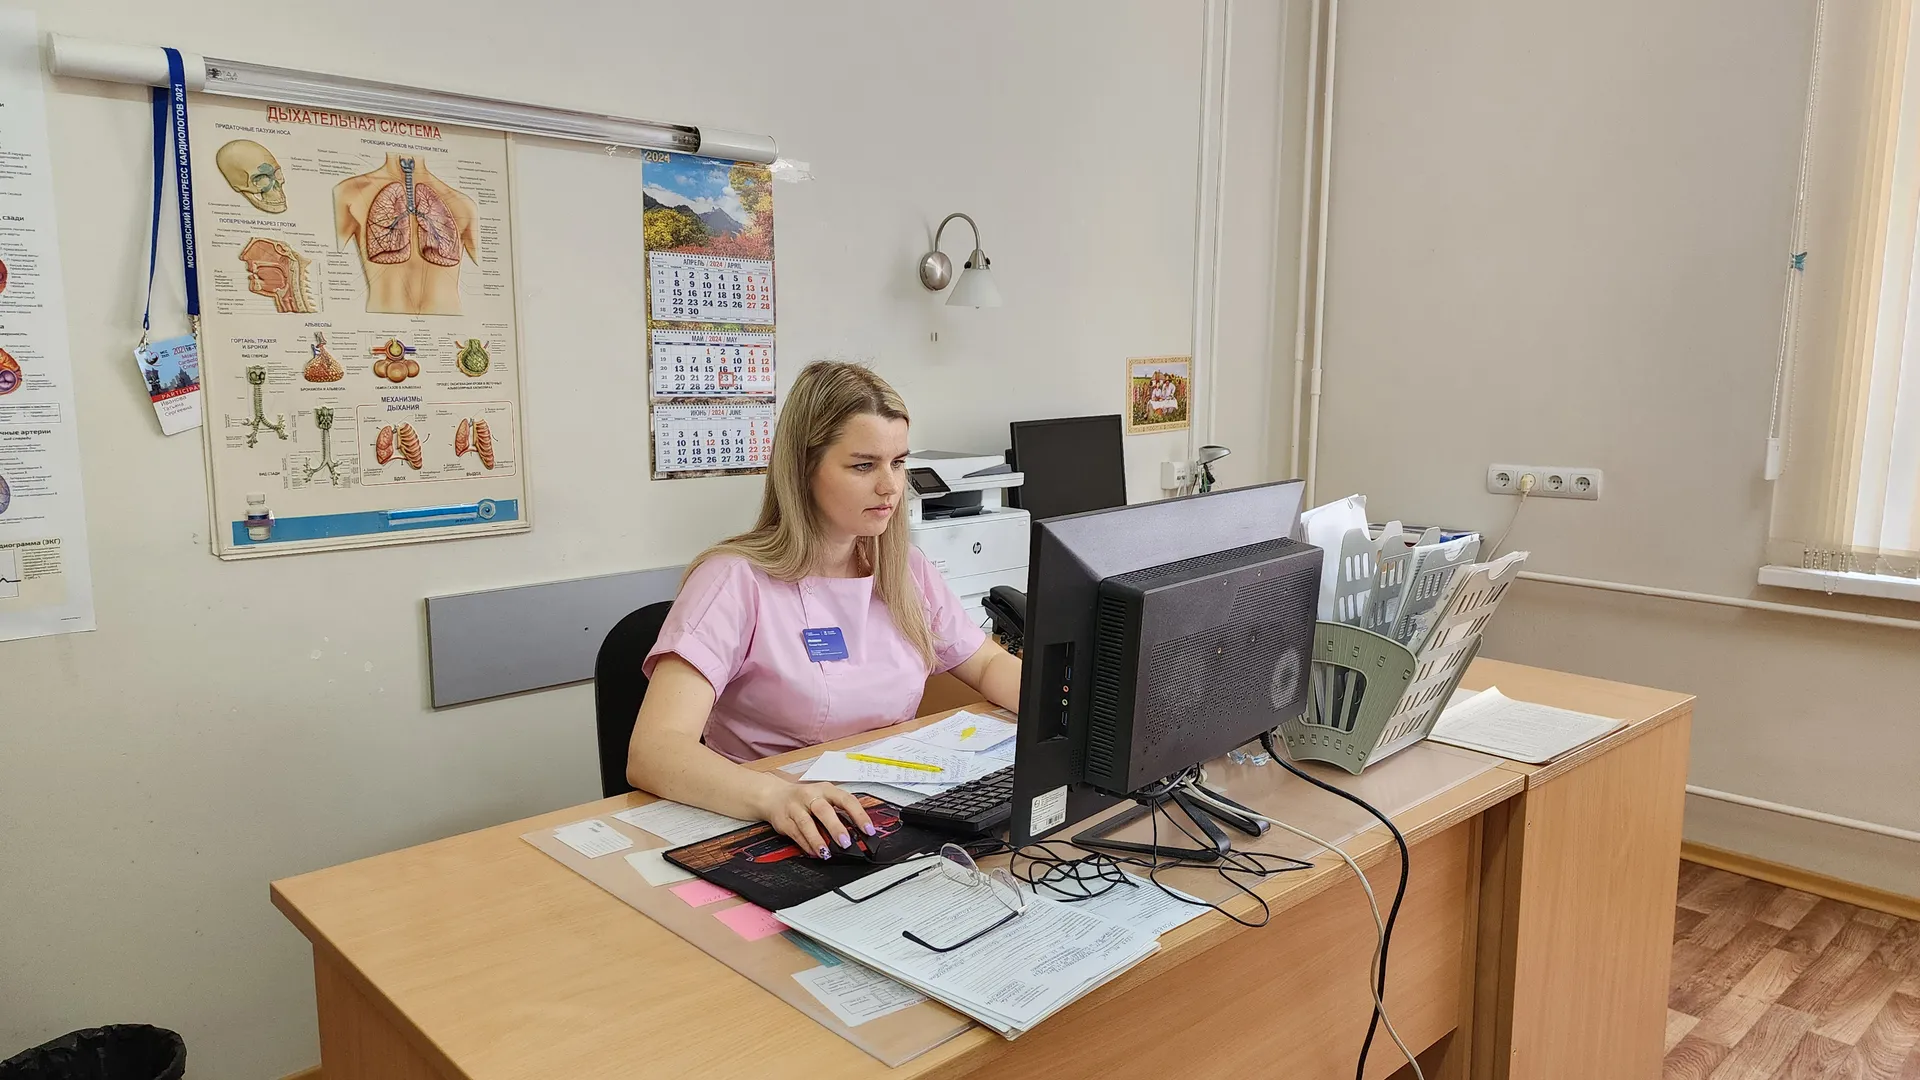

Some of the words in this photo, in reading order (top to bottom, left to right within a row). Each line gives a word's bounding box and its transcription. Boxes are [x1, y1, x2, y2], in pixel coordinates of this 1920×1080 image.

[175, 83, 183, 102] 2021
[176, 103, 188, 166] КАРДИОЛОГОВ
[215, 123, 255, 132] ПРИДАТОЧНЫЕ
[255, 127, 276, 135] ПАЗУХИ
[267, 107, 376, 132] ДЫХАТЕЛЬНАЯ
[380, 120, 442, 139] СИСТЕМА
[360, 138, 385, 147] ПРОЕКЦИЯ
[385, 141, 407, 149] БРОНХОВ
[645, 151, 671, 163] 2024
[181, 167, 190, 210] КОНГРЕСС
[183, 213, 194, 268] МОСКОВСКИЙ
